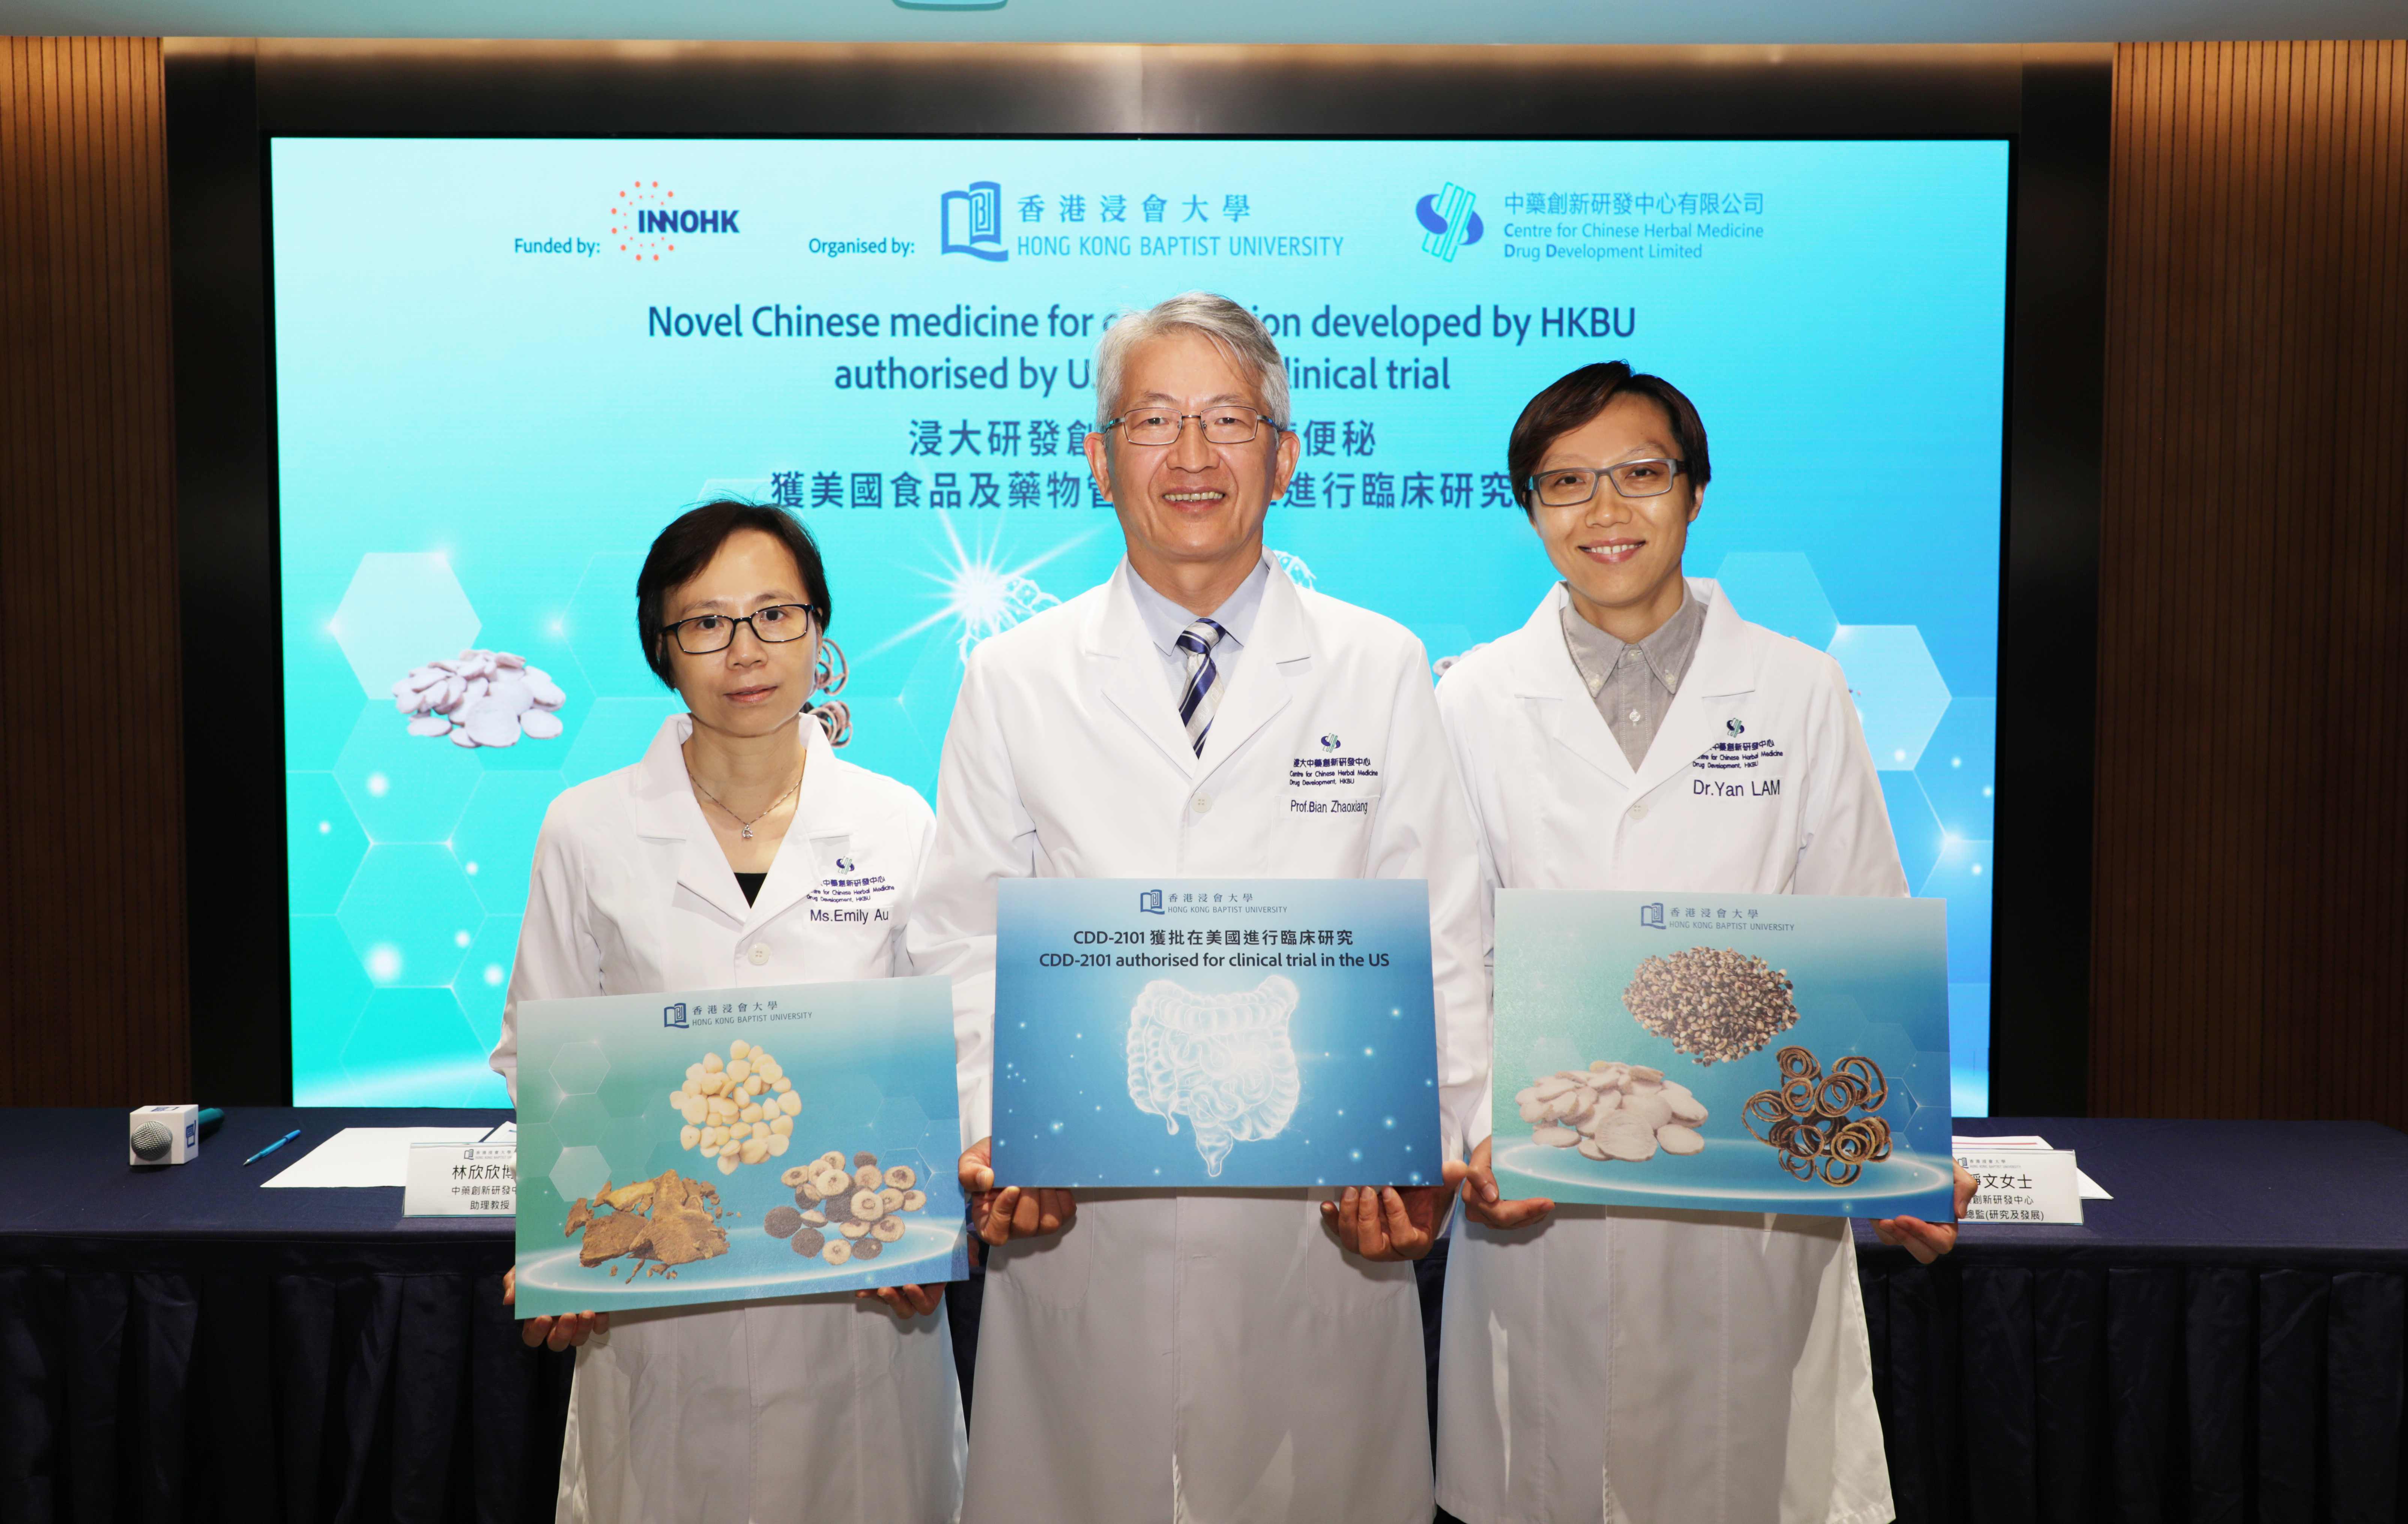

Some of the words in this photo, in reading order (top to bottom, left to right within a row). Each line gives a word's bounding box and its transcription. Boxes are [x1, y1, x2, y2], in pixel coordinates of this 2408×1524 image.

[1017, 193, 1251, 224] 香港浸會大學
[1505, 191, 1763, 216] 中藥創新研發中心有限公司
[638, 209, 740, 234] INNOHK
[1505, 223, 1552, 238] Centre
[1557, 223, 1578, 238] for
[1582, 223, 1639, 238] Chinese
[1644, 223, 1692, 238] Herbal
[1697, 223, 1764, 238] Medicine
[515, 237, 571, 254] Funded
[577, 237, 600, 258] by:
[809, 237, 886, 258] Organised
[891, 237, 915, 258] by:
[1018, 236, 1071, 256] HONG
[1079, 236, 1131, 256] KONG
[1140, 236, 1222, 256] BAPTIST
[1229, 236, 1344, 257] UNIVERSITY
[1505, 244, 1540, 262] Drug
[1546, 244, 1646, 262] Development
[1649, 244, 1702, 259] Limited
[649, 304, 743, 337] Novel
[752, 304, 880, 337] Chinese
[891, 304, 1039, 337] medicine
[1048, 304, 1094, 337] for
[1312, 305, 1481, 346] developed
[1493, 304, 1531, 346] by
[1542, 307, 1634, 337] HKBU
[835, 356, 1008, 390] authorised
[1020, 357, 1058, 398] by
[1386, 357, 1449, 390] trial
[1290, 419, 1376, 457] 便秘
[1270, 471, 1513, 509] 進行臨床研究
[1711, 739, 1775, 751] 中藥創新研發中心
[1693, 761, 1705, 769] Drug
[1693, 779, 1744, 796] Dr.Yan
[1751, 779, 1780, 796] LAM
[1291, 799, 1327, 812] Prof.Bian
[1330, 800, 1368, 815] Zhaoxiang
[821, 876, 885, 887] 中藥創新研發中心
[1168, 893, 1253, 903] 香港浸會大學
[810, 909, 869, 925] Ms.Emily
[874, 909, 888, 921] Au
[1671, 907, 1759, 919] 香港浸會大學
[1716, 922, 1747, 930] BAPTIST
[1750, 923, 1795, 931] UNIVERSITY
[1073, 931, 1145, 944] CDD-2101
[1150, 930, 1353, 945] 獲批在美國進行臨床研究
[1039, 953, 1111, 967] CDD-2101
[1116, 952, 1199, 967] authorised
[1202, 952, 1225, 967] for
[1229, 952, 1282, 967] clinical
[1286, 952, 1317, 967] trial
[1321, 953, 1335, 966] in
[1339, 952, 1365, 967] the
[1369, 953, 1389, 967] US
[692, 1001, 778, 1015] 香港浸會大學
[738, 1014, 767, 1023] BAPTIST
[770, 1012, 813, 1021] UNIVERSITY
[470, 1200, 510, 1210] 助理教授
